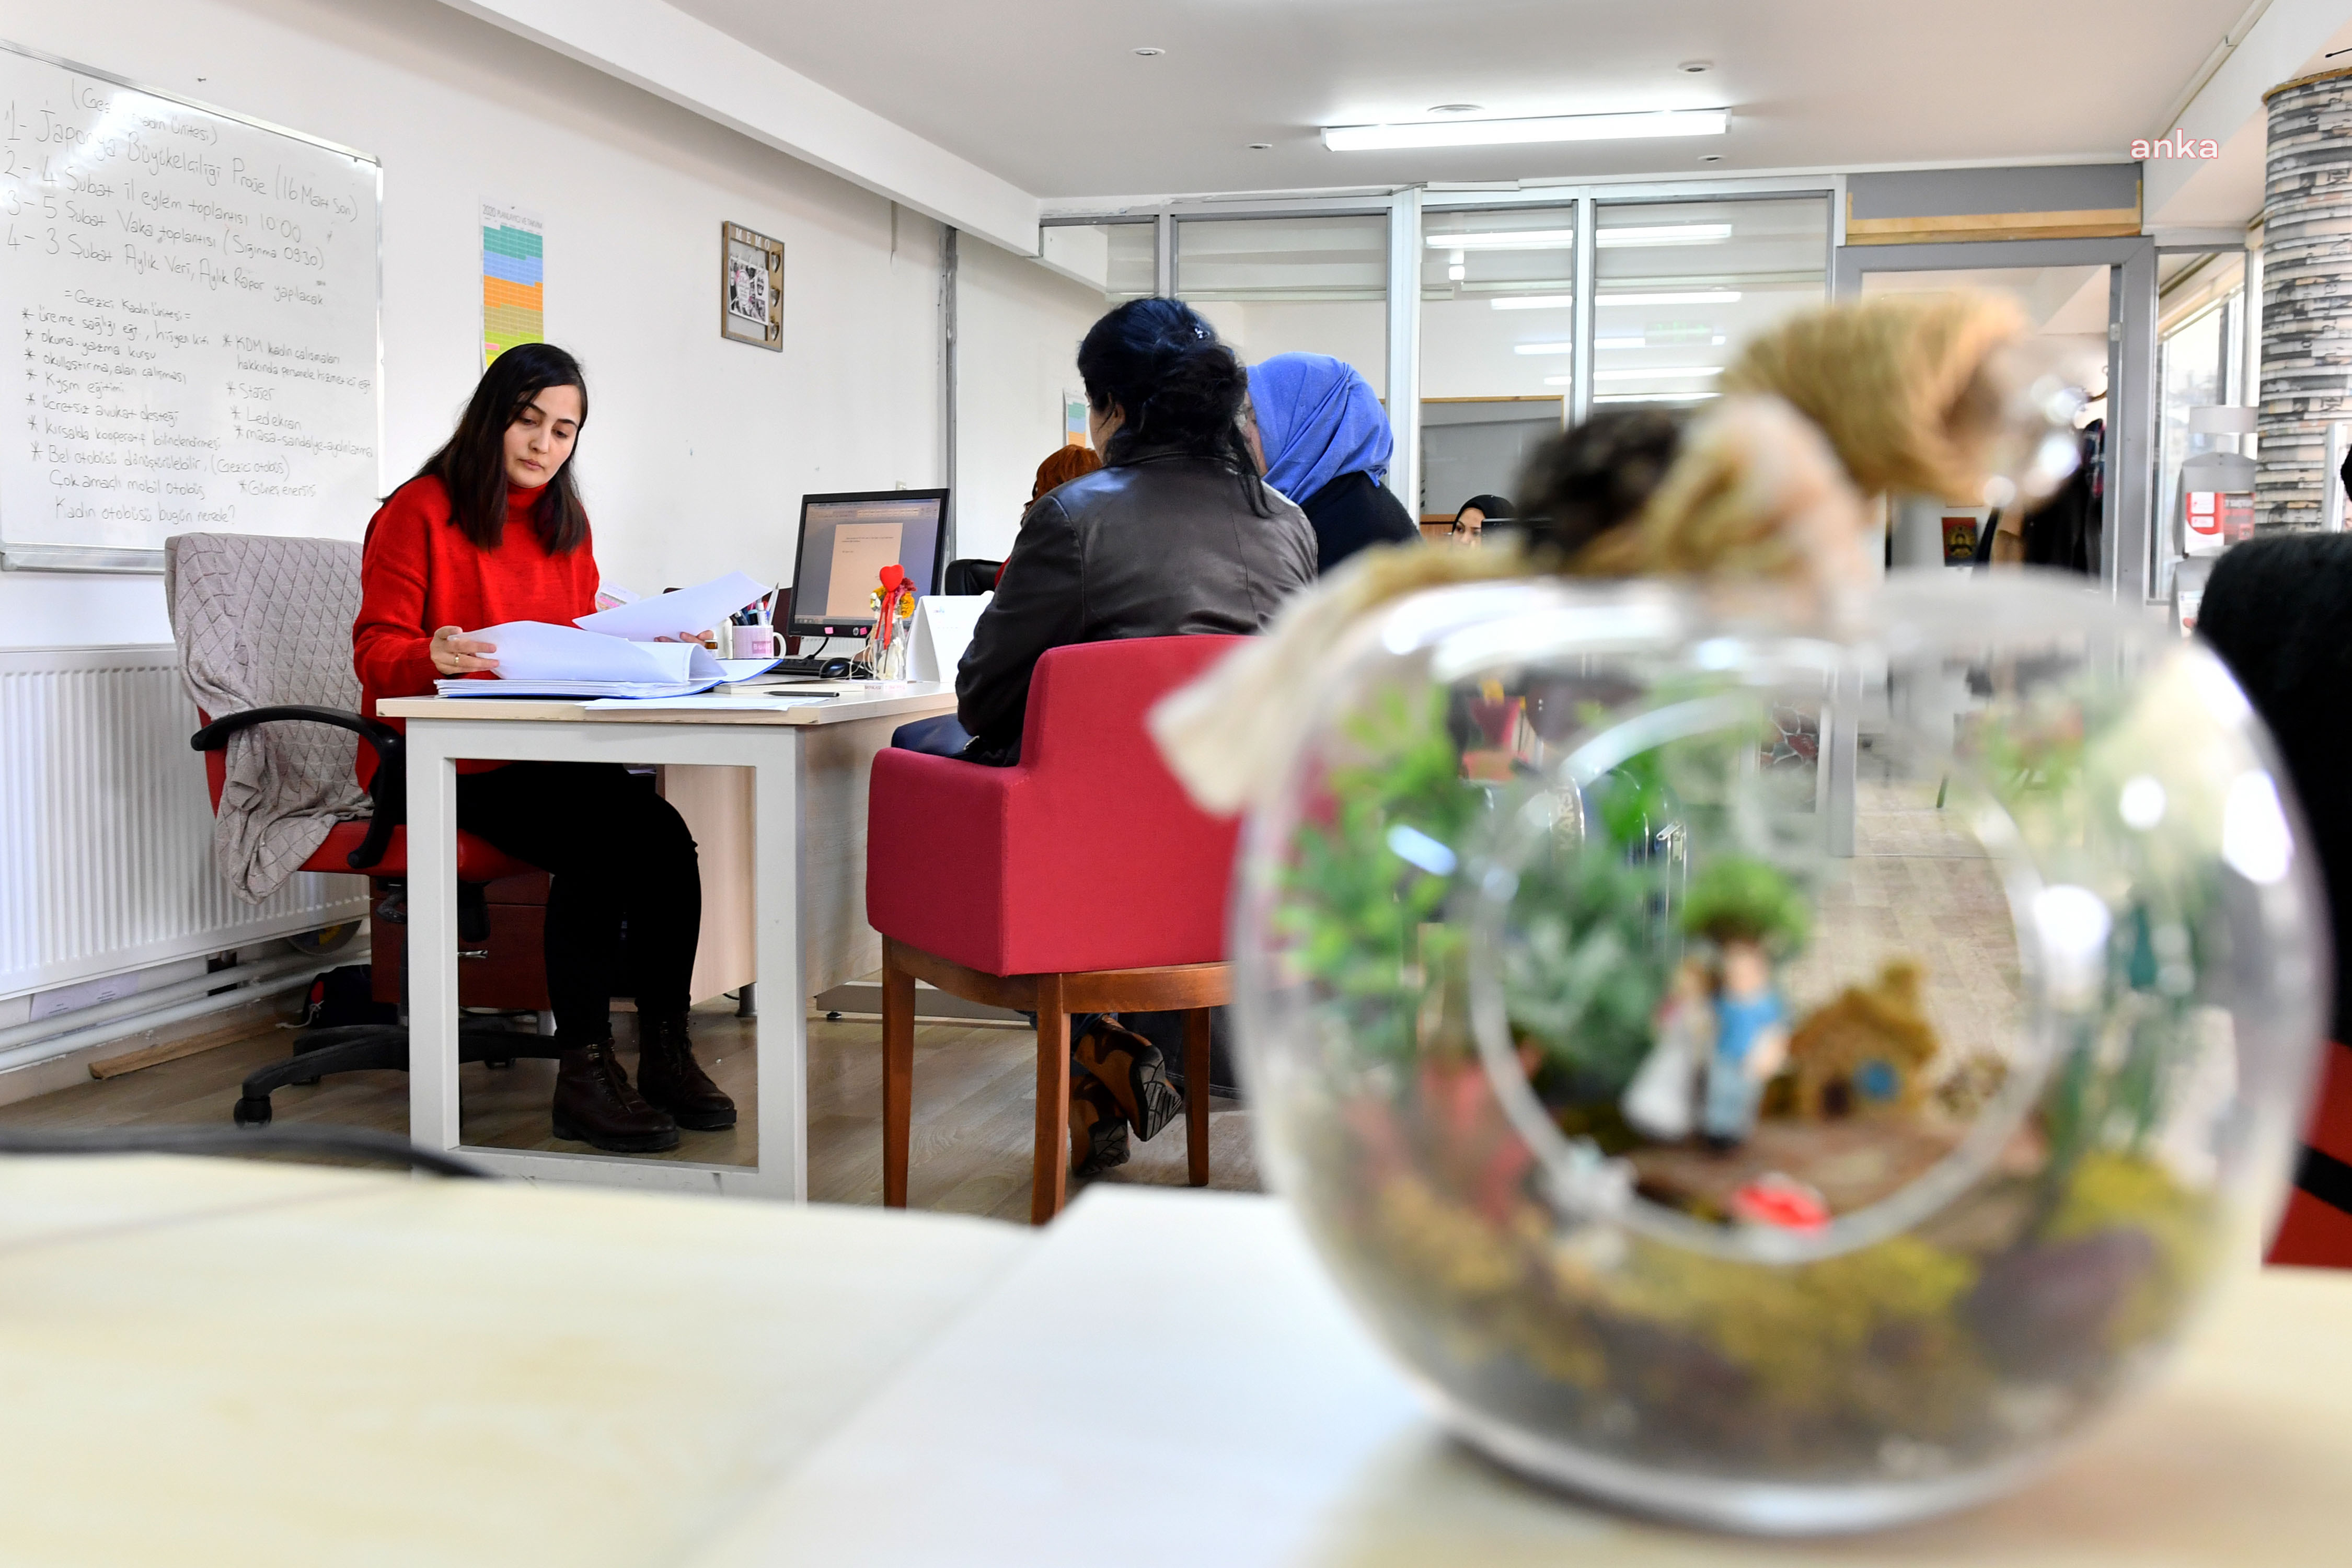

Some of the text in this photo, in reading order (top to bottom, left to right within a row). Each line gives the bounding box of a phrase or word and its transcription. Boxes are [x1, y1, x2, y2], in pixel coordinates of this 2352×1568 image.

[142, 190, 182, 211] eylem
[188, 199, 248, 227] toplantısı
[43, 195, 57, 219] 5
[117, 209, 153, 237] Vaka
[159, 225, 216, 248] toplantısı
[735, 227, 770, 250] MEMO
[45, 228, 60, 255] 3
[125, 244, 159, 275] Aylık
[200, 258, 229, 291] Aylık
[234, 267, 264, 291] Rapor
[274, 286, 324, 305] yapılacak
[39, 304, 75, 326] üreme
[128, 345, 156, 360] kursu
[114, 363, 137, 377] alan
[128, 479, 160, 494] mobil
[158, 501, 193, 525] bugün
